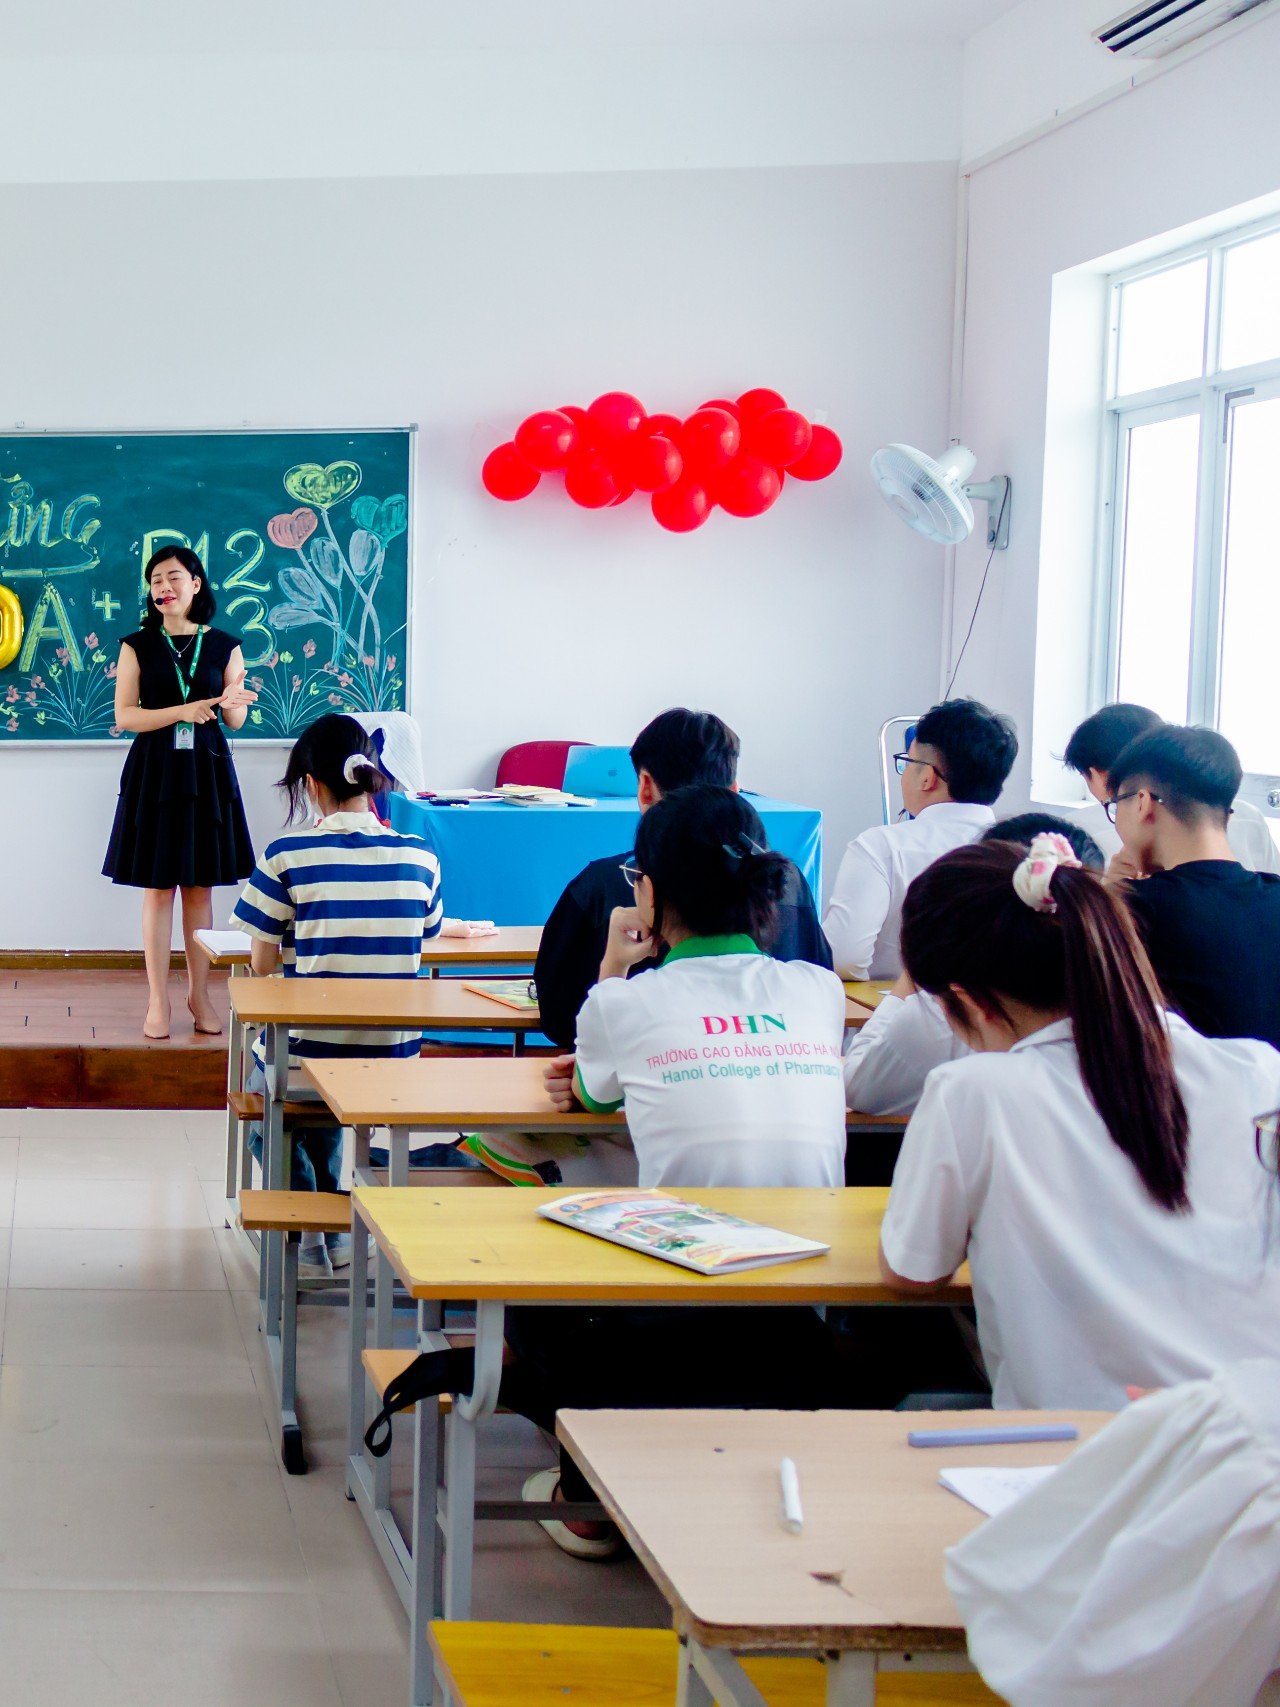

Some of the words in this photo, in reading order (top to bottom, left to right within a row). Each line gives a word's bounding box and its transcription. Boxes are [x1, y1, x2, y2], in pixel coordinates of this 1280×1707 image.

[699, 1014, 787, 1035] DHN
[646, 1048, 698, 1070] TRƯỜNG
[702, 1046, 730, 1059] CAO
[734, 1042, 772, 1058] ĐẲNG
[662, 1066, 704, 1084] Hanoi
[708, 1062, 761, 1080] College
[766, 1062, 780, 1076] of
